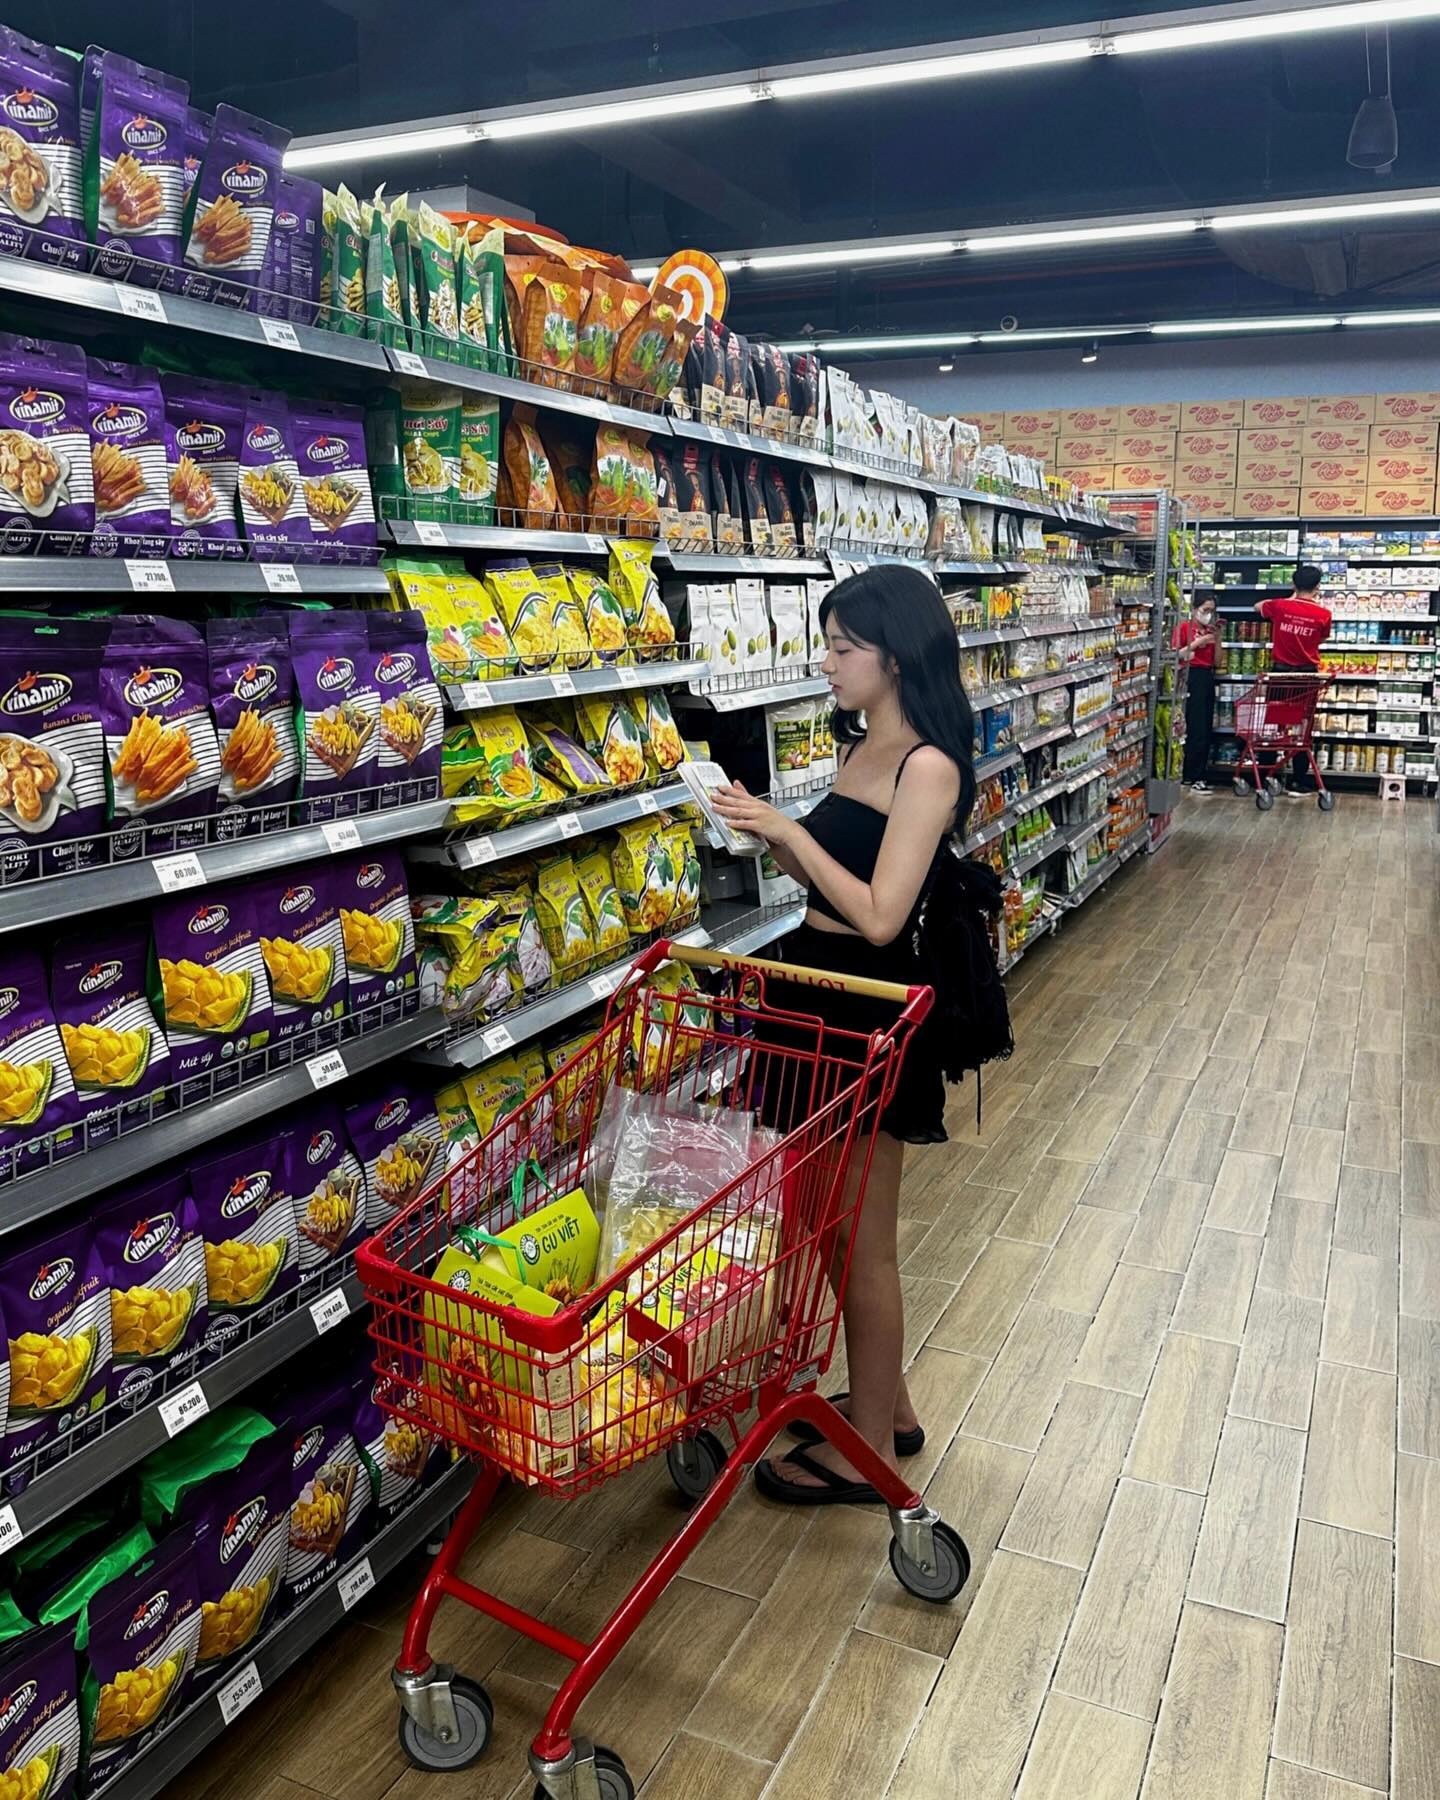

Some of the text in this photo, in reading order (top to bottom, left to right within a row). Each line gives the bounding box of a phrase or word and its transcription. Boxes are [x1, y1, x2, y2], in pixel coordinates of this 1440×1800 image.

[9, 102, 52, 120] vinamit
[127, 128, 162, 144] vinamit
[227, 172, 264, 187] vinamit
[15, 396, 58, 418] vinamit
[98, 413, 140, 432] vinamit
[178, 428, 220, 446] vinamit
[252, 432, 279, 448] vinamit
[311, 443, 344, 458] vinamit
[323, 662, 353, 689] vinamit
[381, 660, 412, 682] vinamit
[6, 678, 65, 712] vinamit
[130, 672, 176, 704] vinamit
[240, 670, 271, 697] vinamit
[43, 712, 92, 730] Banana Chips
[173, 866, 197, 879] 60.700
[360, 866, 381, 888] vinamit
[283, 888, 310, 912] vinamit
[193, 910, 225, 934] vinamit
[82, 965, 118, 992] vinamit
[378, 1103, 406, 1130] vinamit
[310, 1134, 332, 1162] vinamit
[225, 1176, 268, 1216] vinamit
[130, 1218, 170, 1261] vinamit
[542, 1233, 558, 1254] GU
[557, 1216, 580, 1244] VIỆT
[34, 1262, 71, 1299] vinamit
[659, 1280, 675, 1296] GU
[46, 1302, 74, 1328] Organic
[177, 1394, 201, 1416] 86.200
[222, 1503, 260, 1560] vinamit
[129, 1594, 167, 1637] vinamit
[232, 1675, 255, 1703] 155.300
